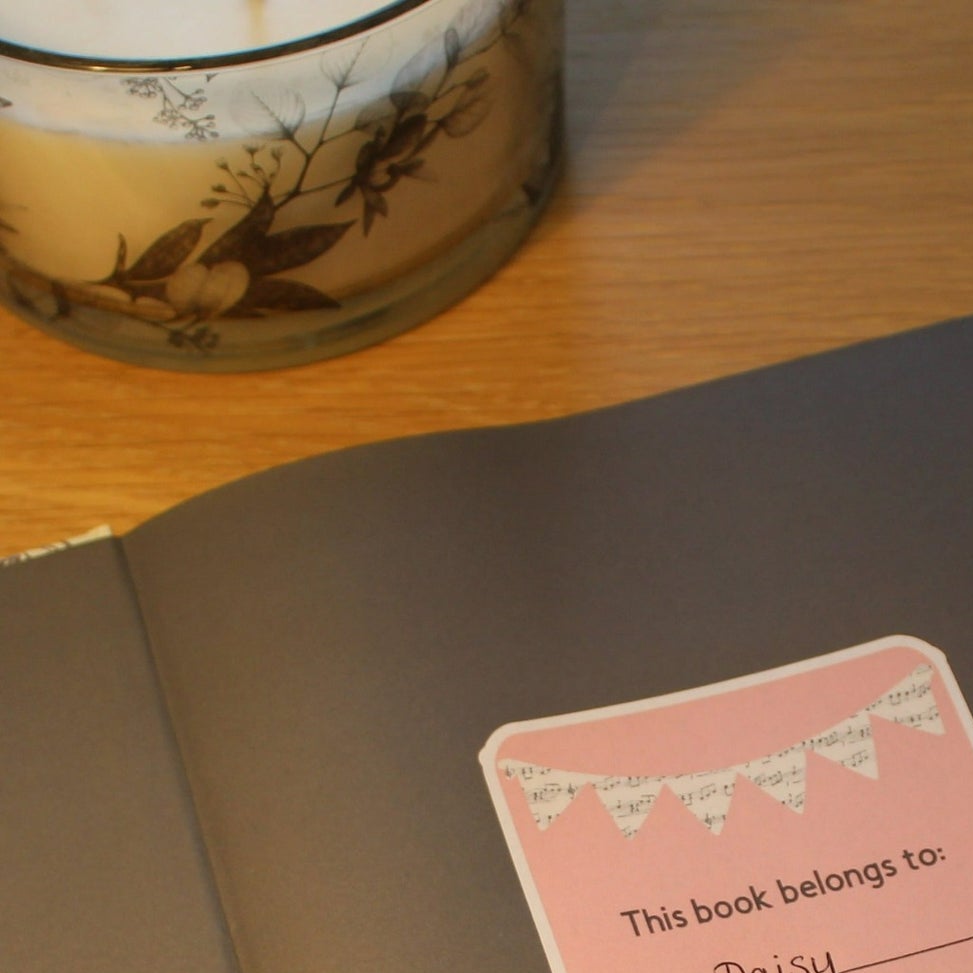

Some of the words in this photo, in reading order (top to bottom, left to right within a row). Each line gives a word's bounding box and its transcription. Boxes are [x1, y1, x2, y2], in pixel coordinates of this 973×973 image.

[620, 906, 688, 937] This
[690, 885, 773, 924] book
[776, 858, 898, 904] belongs
[901, 846, 946, 871] to:
